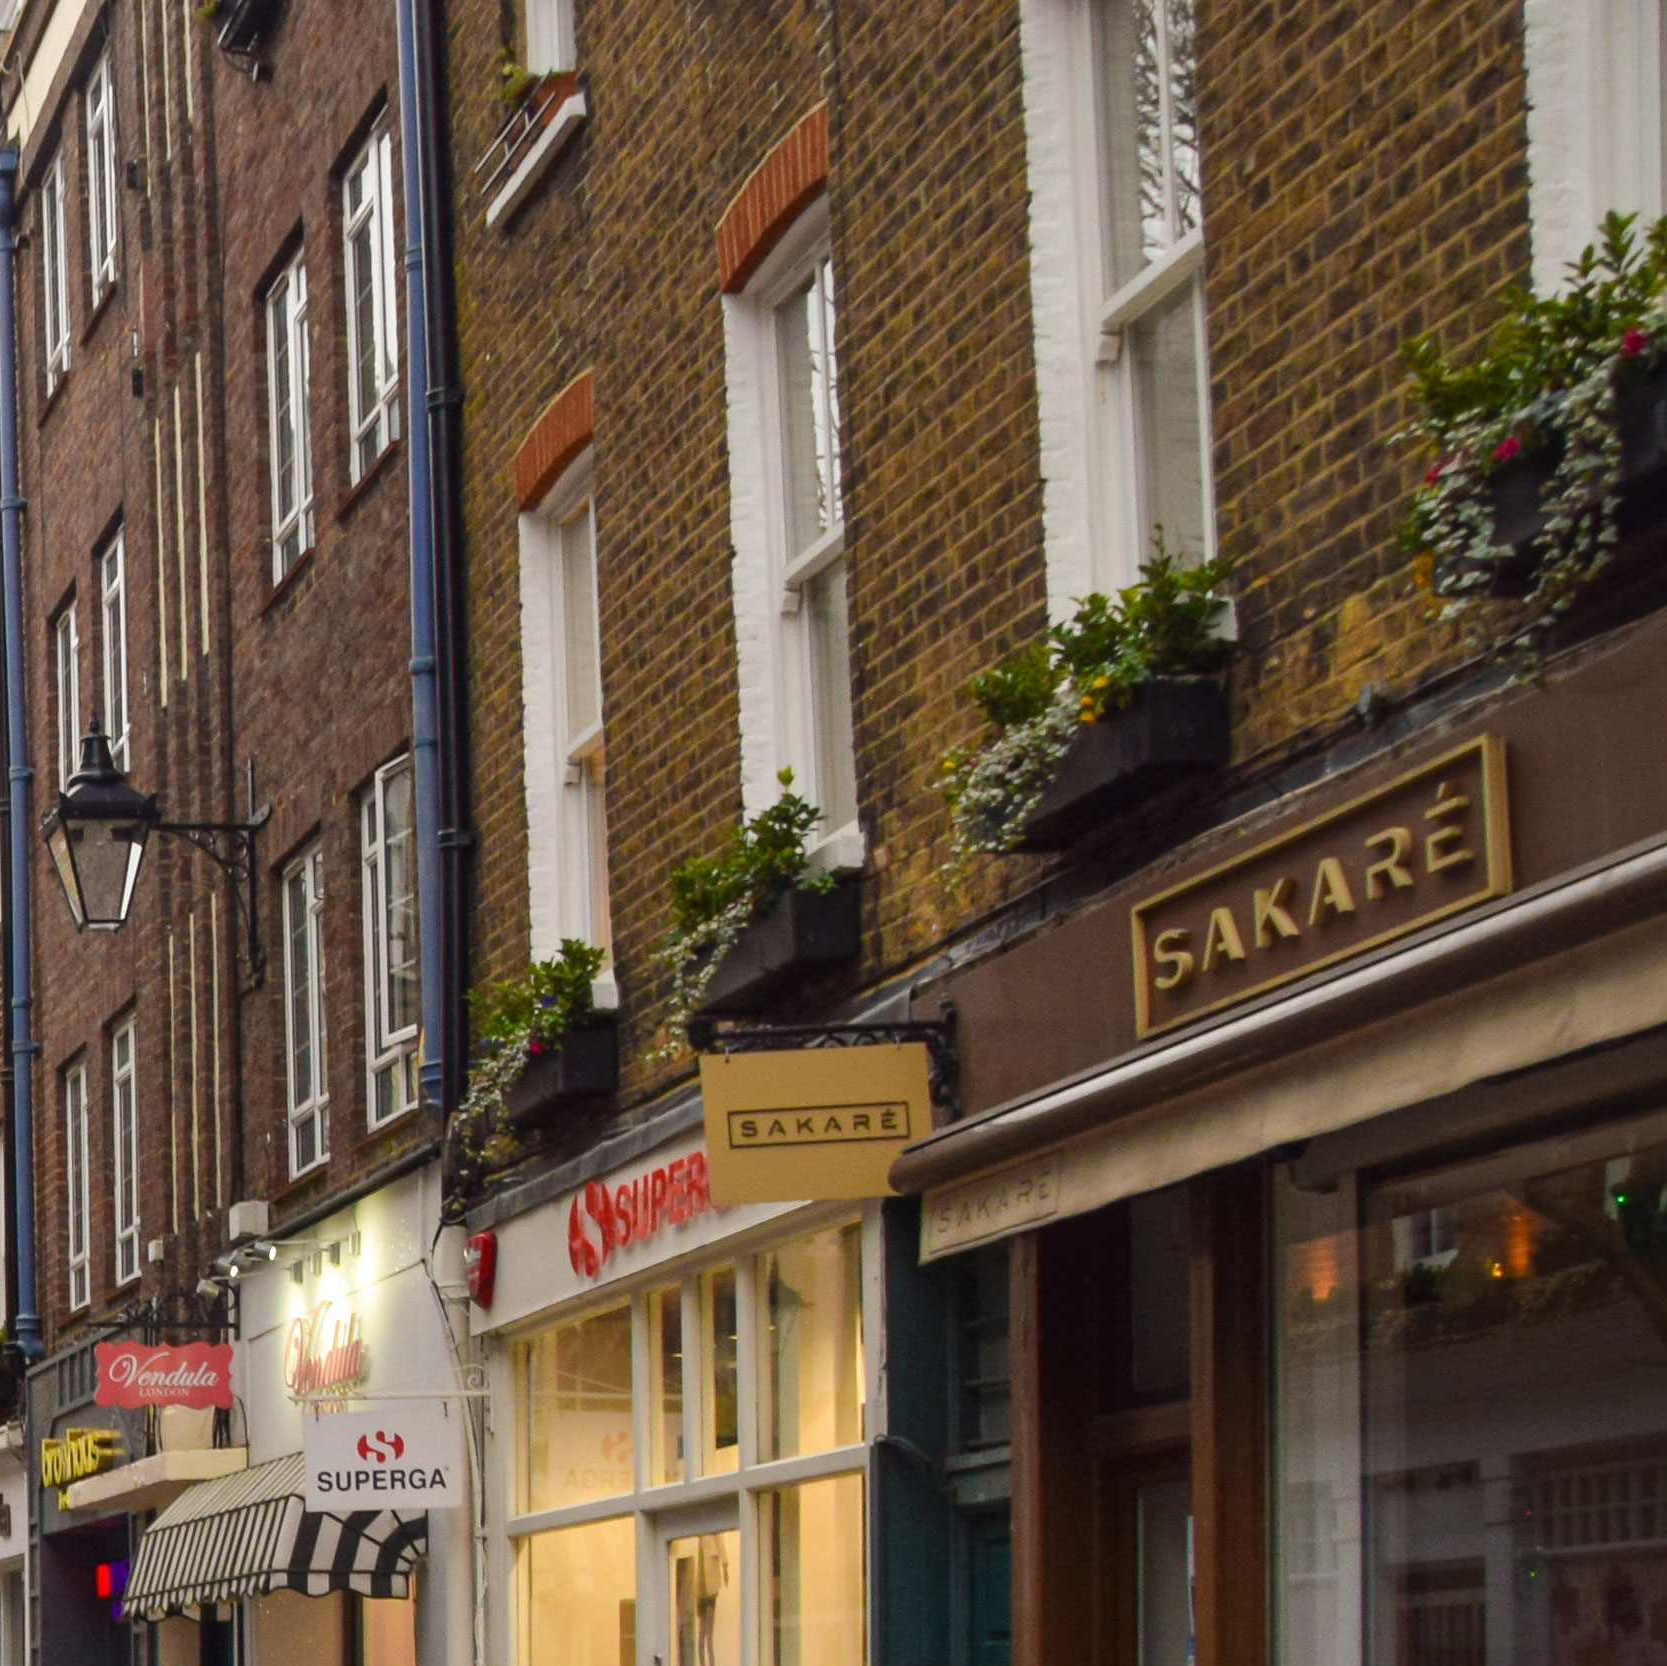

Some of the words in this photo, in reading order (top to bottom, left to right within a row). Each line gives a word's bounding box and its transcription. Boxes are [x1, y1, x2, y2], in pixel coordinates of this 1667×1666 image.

[1153, 781, 1475, 991] SAKARÉ
[740, 1109, 899, 1138] SAKARÉ
[615, 1151, 710, 1246] SUPER
[108, 1351, 219, 1387] Vendula
[139, 1387, 191, 1397] LONDON
[317, 1468, 447, 1493] SUPERGA
